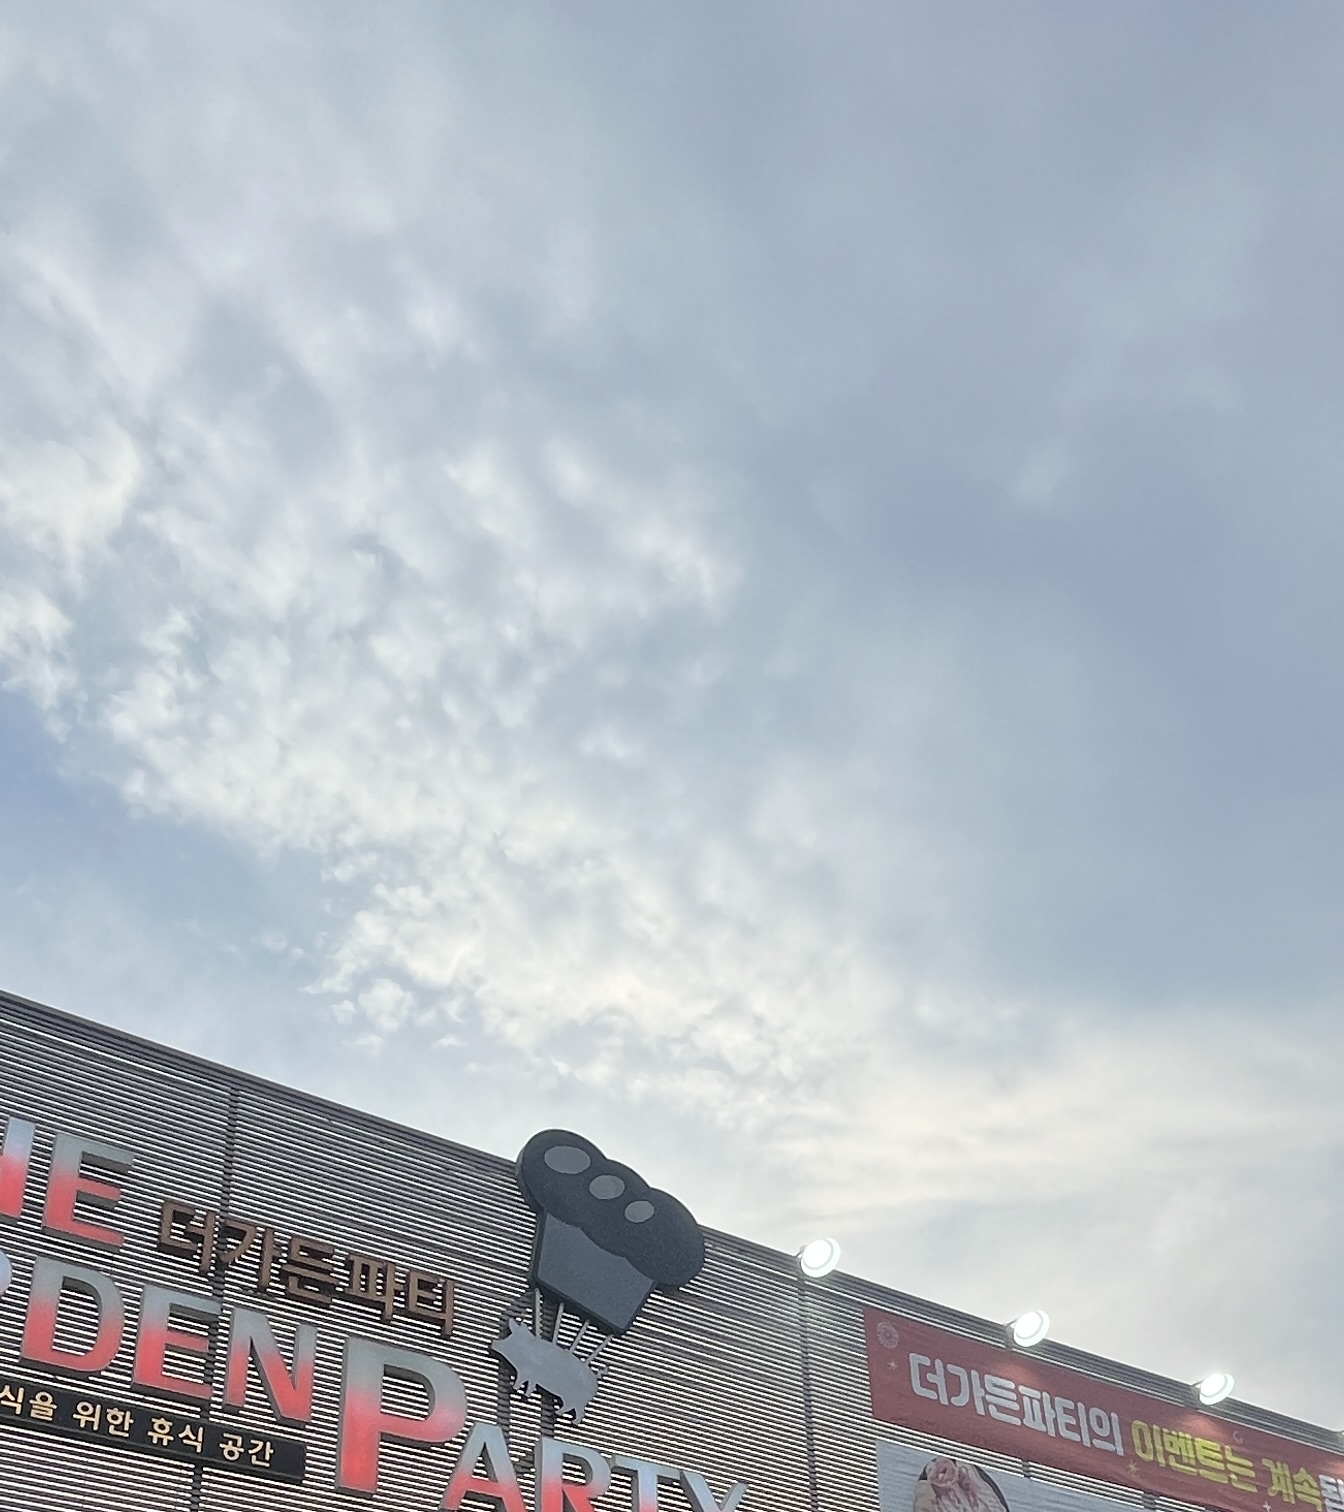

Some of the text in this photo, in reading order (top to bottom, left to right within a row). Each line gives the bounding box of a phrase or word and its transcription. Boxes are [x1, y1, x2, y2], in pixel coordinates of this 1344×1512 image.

[156, 1199, 456, 1338] 더가든파티
[73, 1401, 135, 1438] 위한
[147, 1418, 206, 1453] 휴식
[219, 1432, 275, 1467] 공간
[909, 1352, 1124, 1456] 더가든파티의
[1131, 1420, 1258, 1493] 이벤트는
